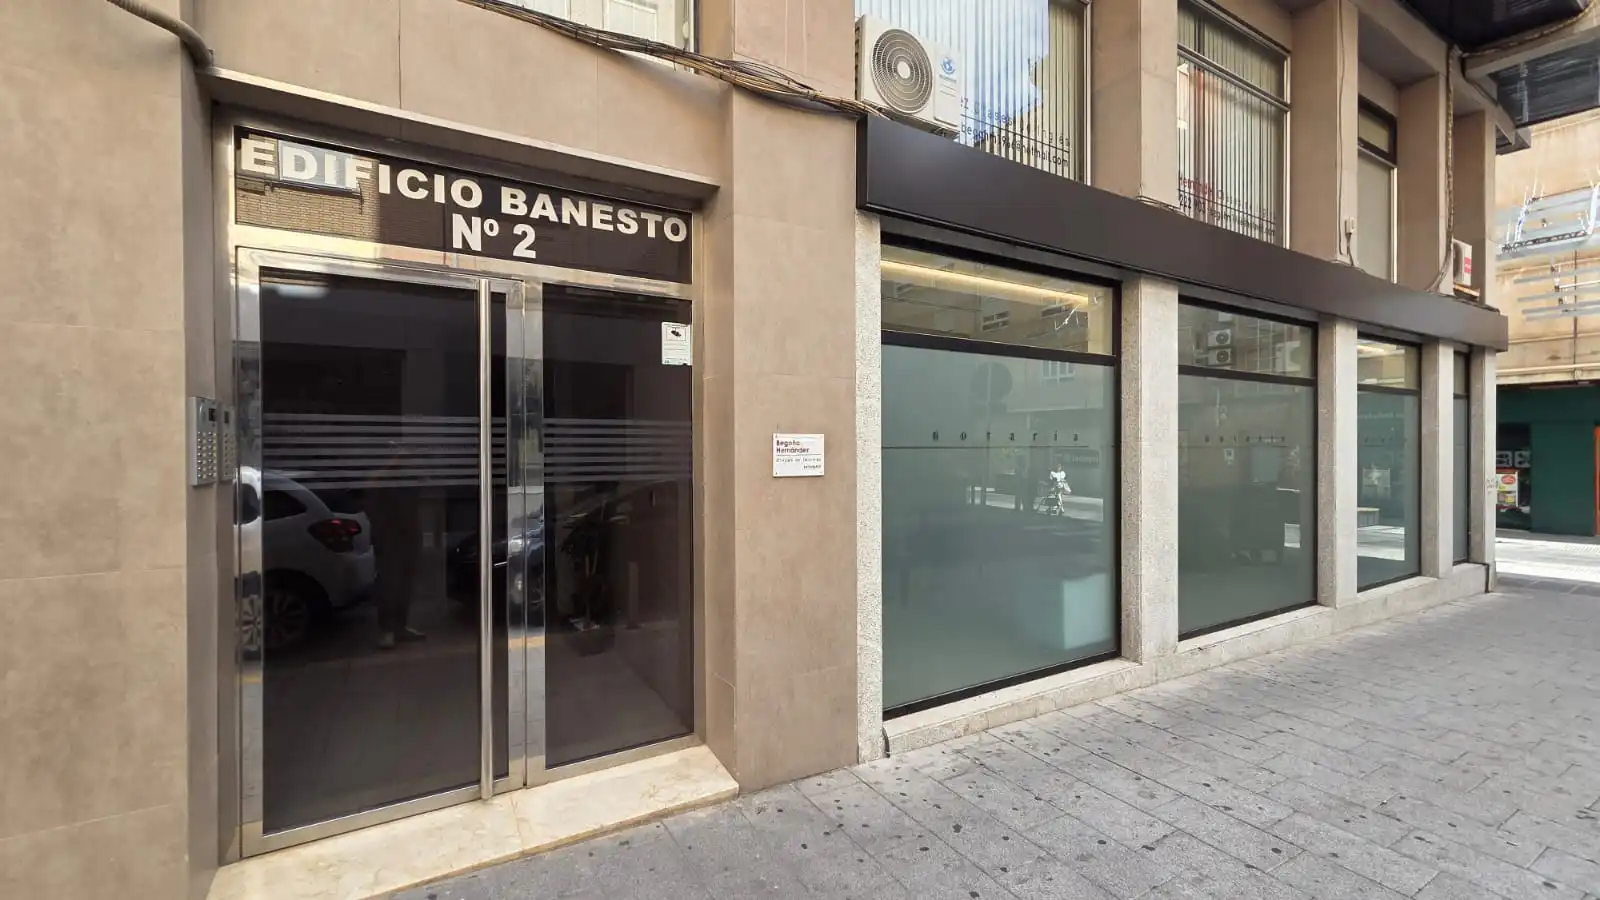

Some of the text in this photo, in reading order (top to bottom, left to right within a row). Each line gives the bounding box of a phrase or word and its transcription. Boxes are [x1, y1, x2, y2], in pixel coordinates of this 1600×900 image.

[240, 137, 687, 242] EDIFICIO BANESTO
[512, 223, 537, 259] 2
